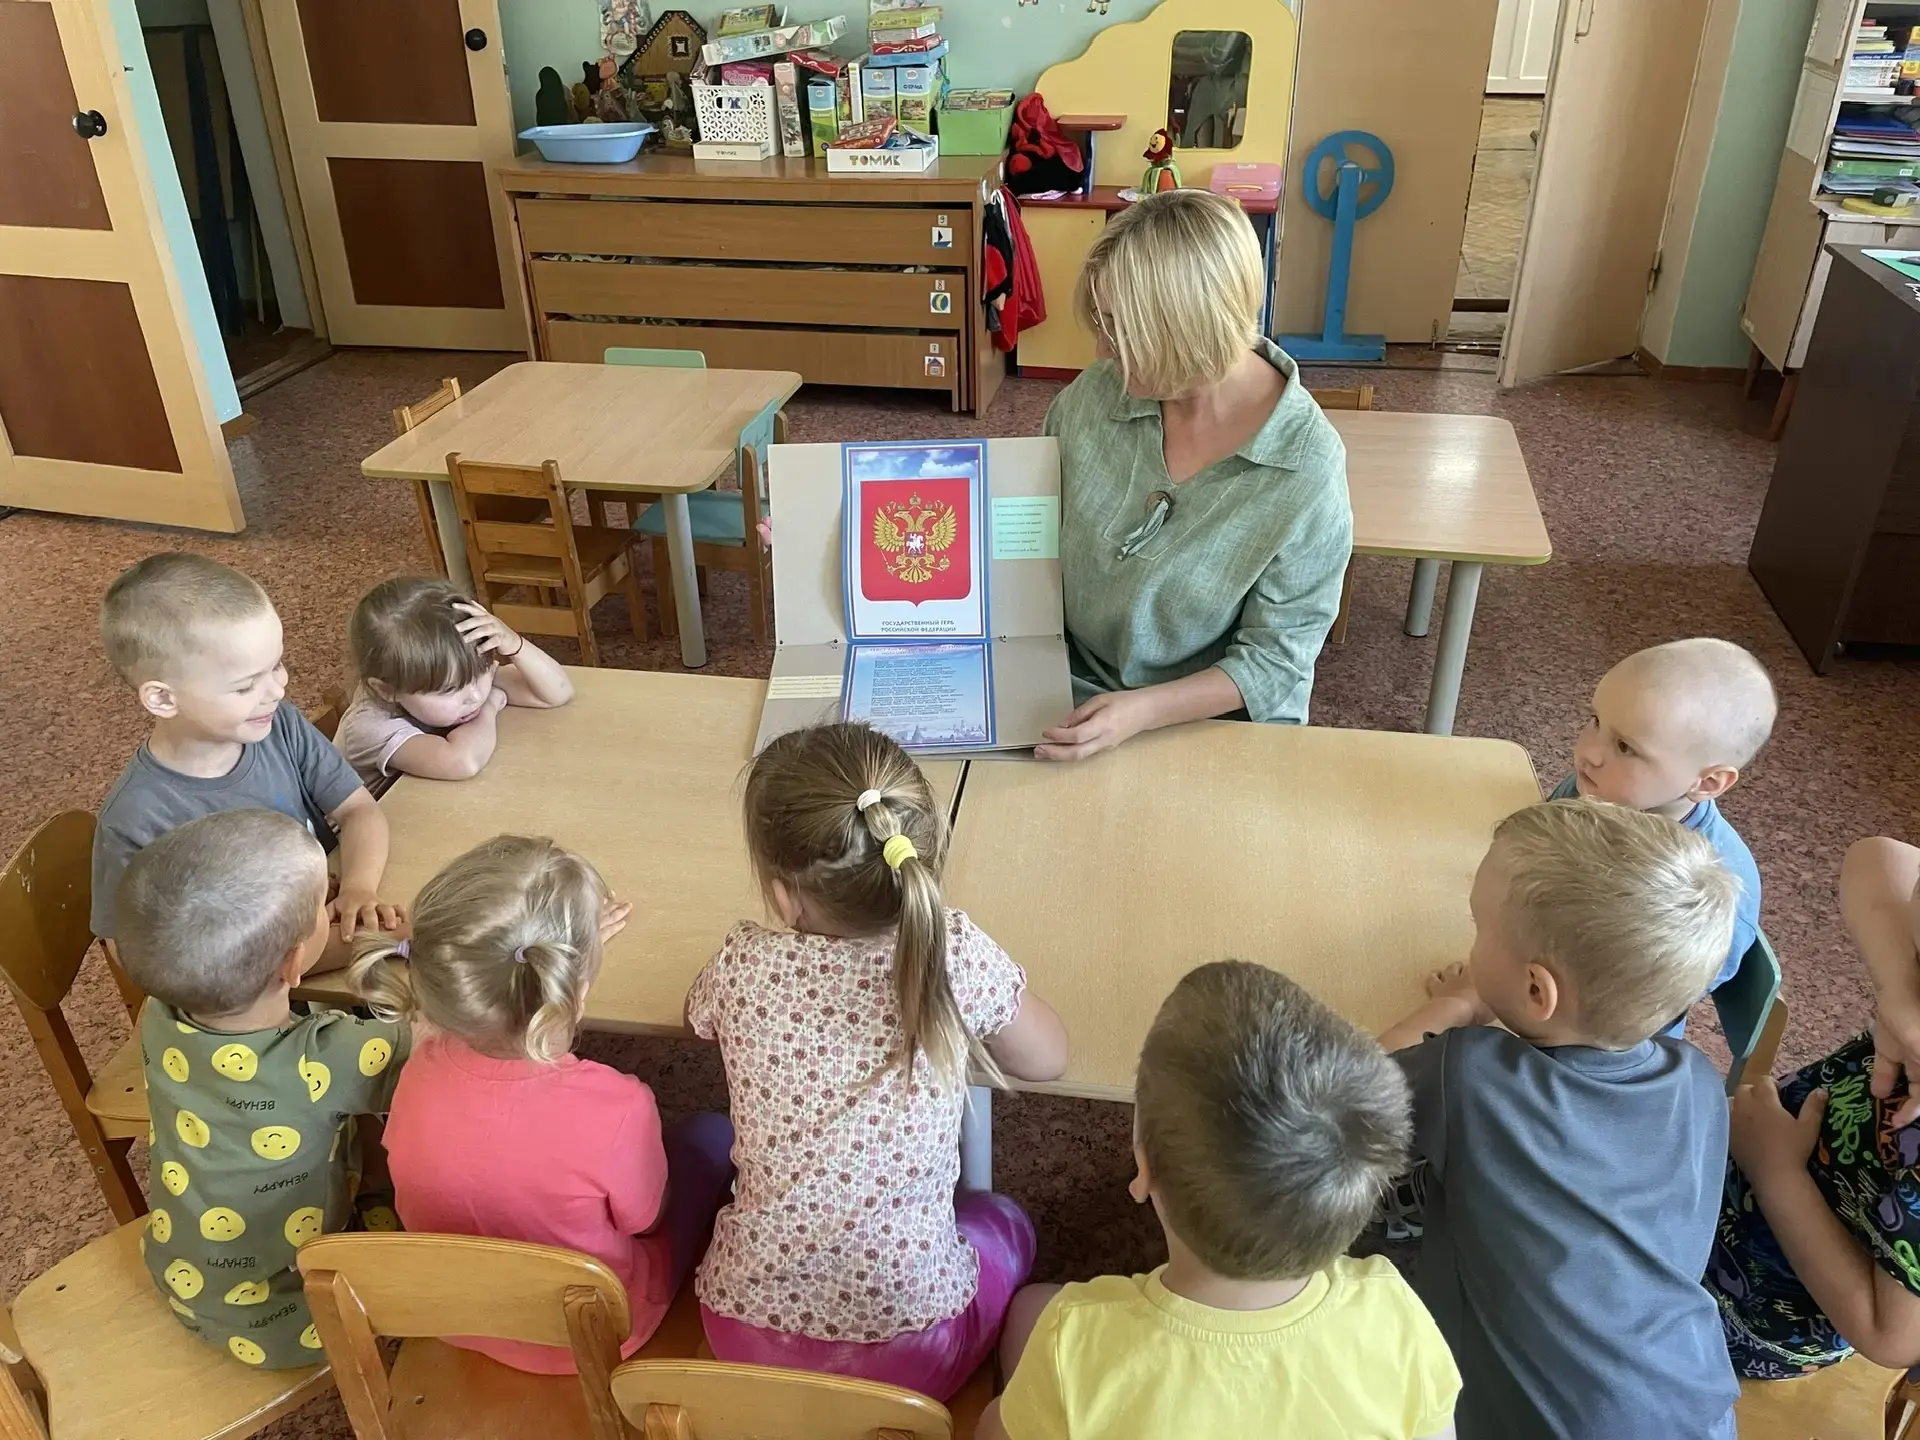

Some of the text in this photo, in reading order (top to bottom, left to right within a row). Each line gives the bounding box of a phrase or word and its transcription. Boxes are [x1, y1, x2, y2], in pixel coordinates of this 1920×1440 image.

[849, 155, 901, 166] ТОМИК
[225, 1096, 276, 1111] BEHAPPY
[252, 1171, 309, 1195] BEHAPPY
[205, 1256, 256, 1269] BEHAPPY
[246, 1302, 297, 1329] BEHAPPY
